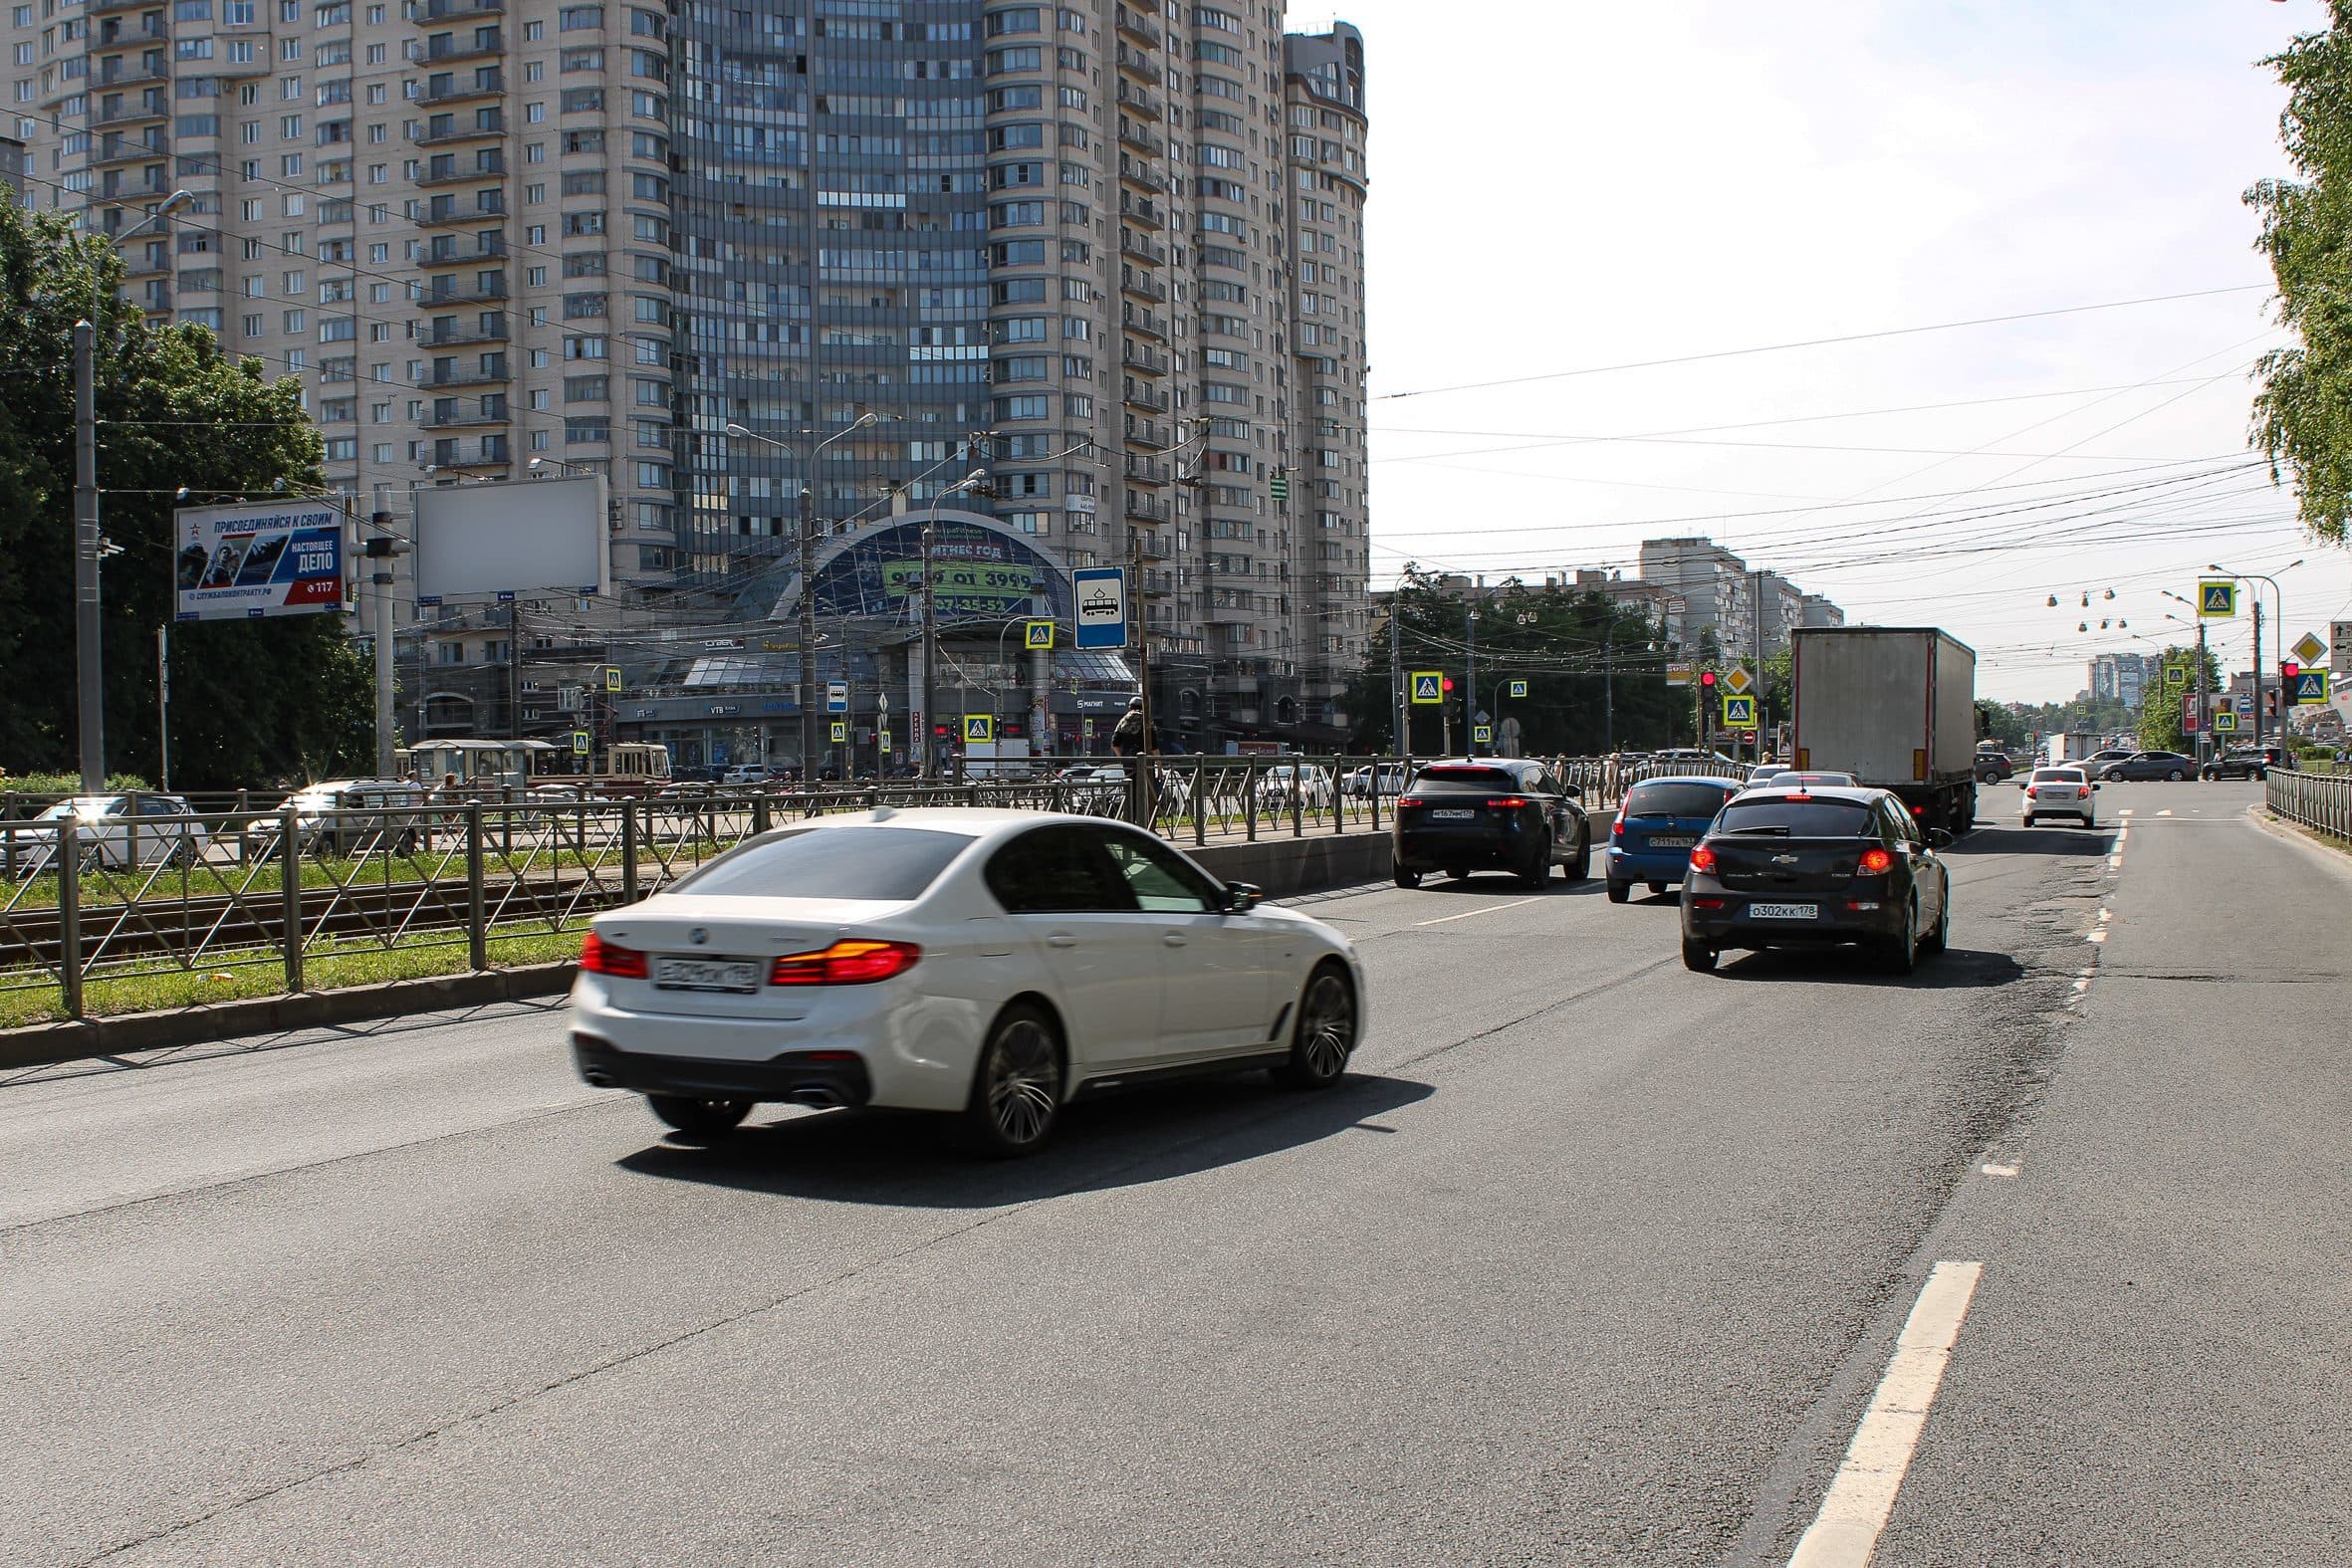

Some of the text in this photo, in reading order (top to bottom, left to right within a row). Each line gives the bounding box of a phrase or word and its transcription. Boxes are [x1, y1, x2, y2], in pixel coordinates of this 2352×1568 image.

[214, 513, 333, 534] ПРИСОЕДИНЯЙСЯ К СВОИМ
[292, 541, 334, 553] НАСТОЯЩЕЕ
[299, 553, 334, 573] ДЕЛО
[891, 571, 945, 583] 99
[317, 581, 334, 593] 117
